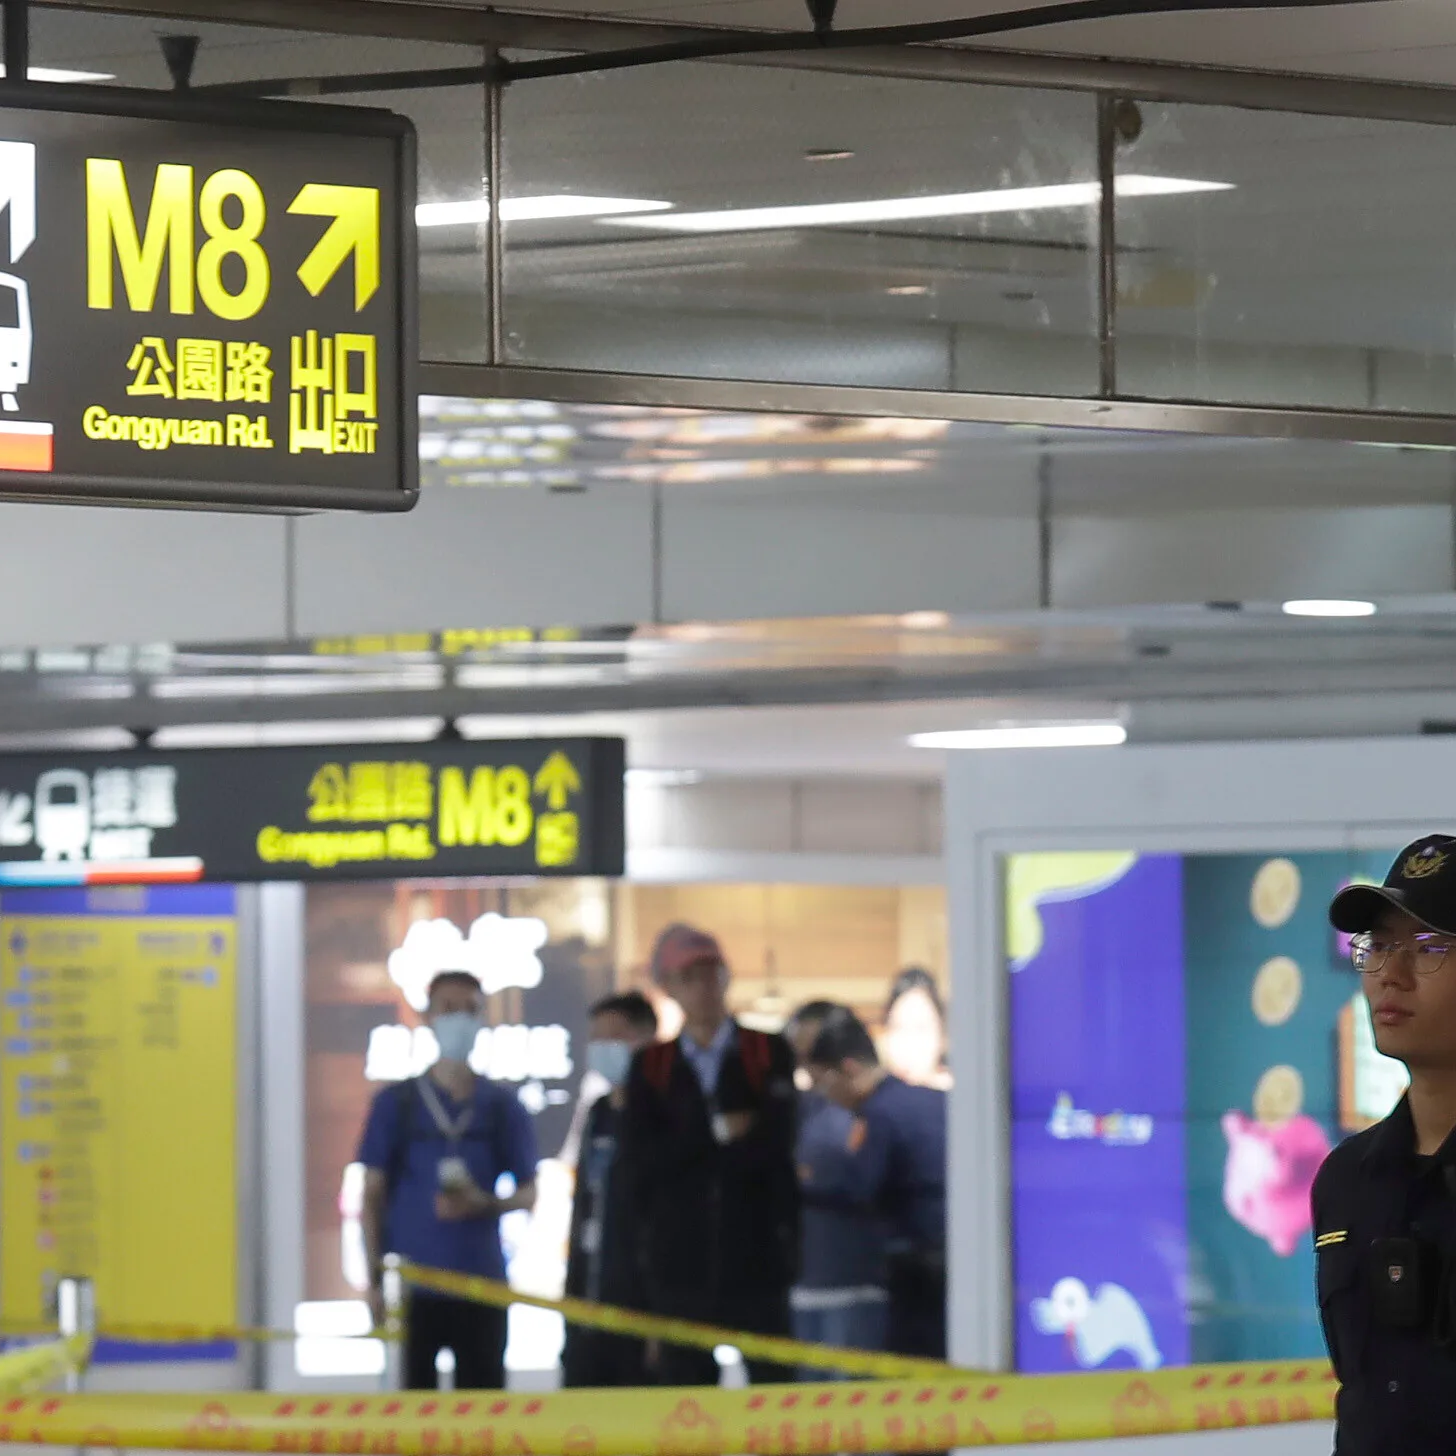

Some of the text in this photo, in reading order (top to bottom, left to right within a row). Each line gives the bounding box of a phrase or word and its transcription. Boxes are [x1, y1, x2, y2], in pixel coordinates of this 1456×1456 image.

[86, 158, 271, 321] M8
[126, 336, 274, 404] 公園路
[289, 329, 377, 454] 出口
[83, 405, 274, 450] Gongyuan Rd.
[333, 420, 378, 453] EXIT
[438, 765, 534, 847] M8
